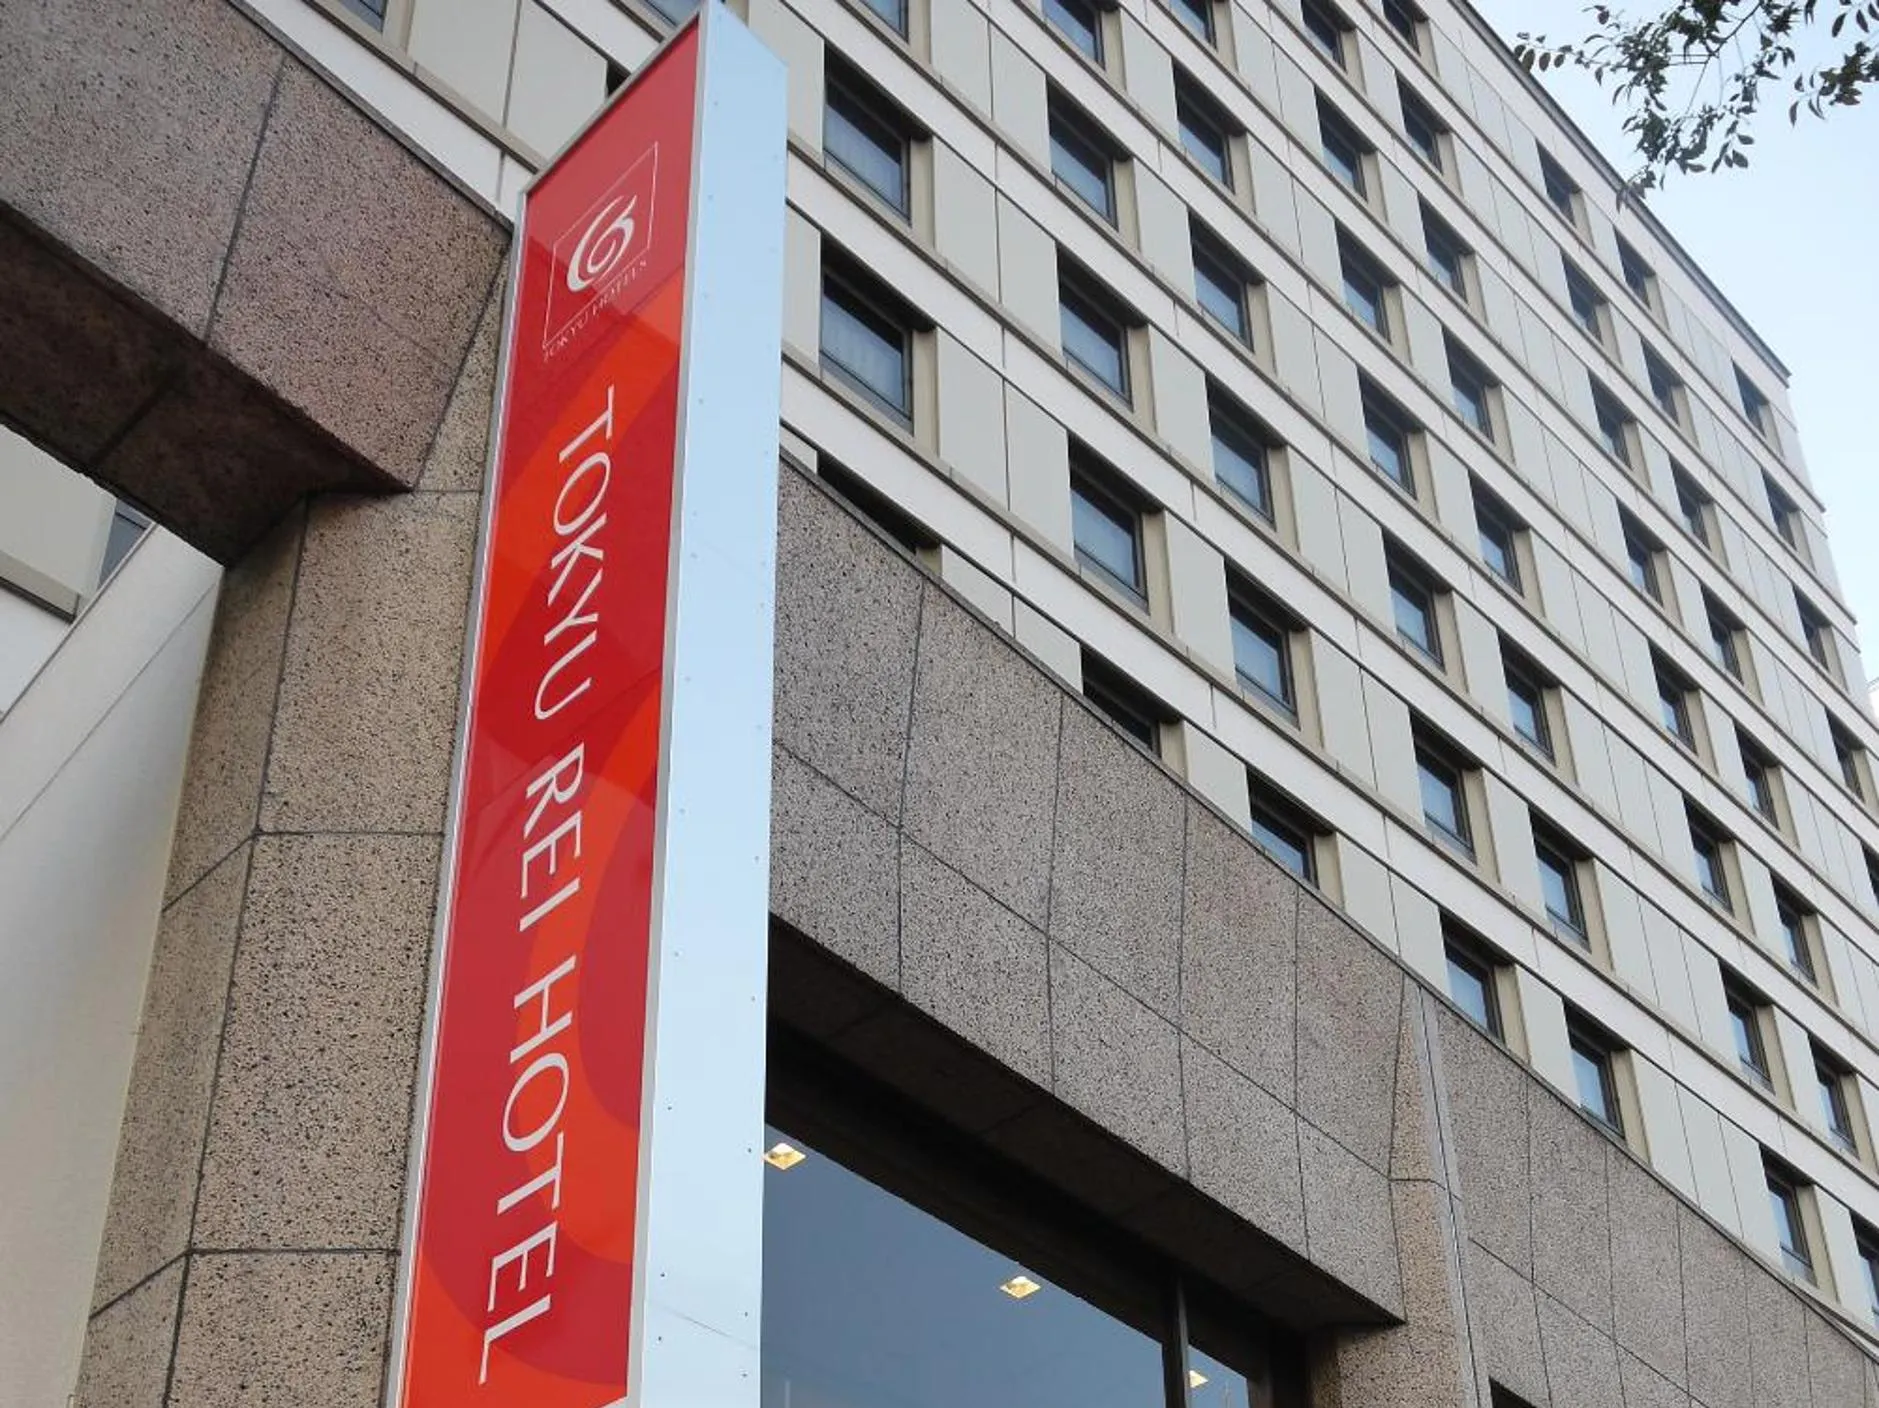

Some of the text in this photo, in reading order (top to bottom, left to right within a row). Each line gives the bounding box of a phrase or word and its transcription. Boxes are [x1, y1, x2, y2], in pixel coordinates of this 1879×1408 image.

[478, 384, 615, 1386] TOKYU REI HOTEL
